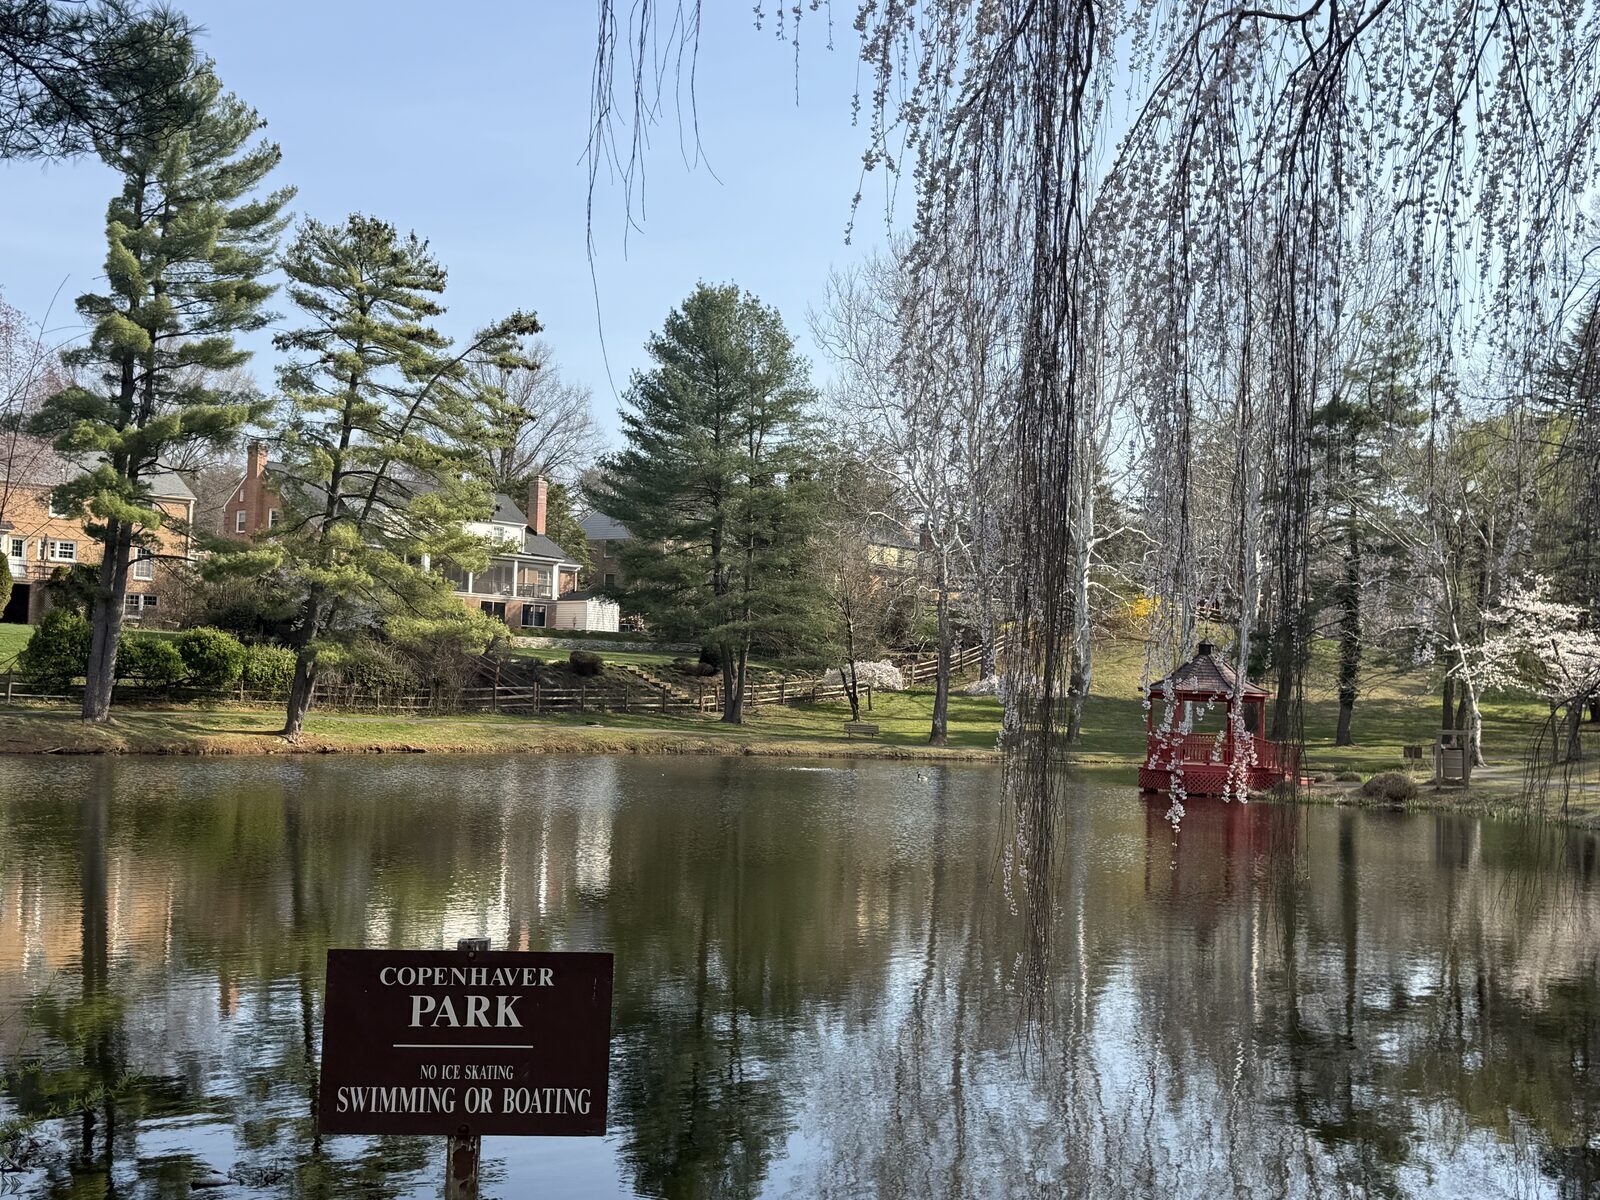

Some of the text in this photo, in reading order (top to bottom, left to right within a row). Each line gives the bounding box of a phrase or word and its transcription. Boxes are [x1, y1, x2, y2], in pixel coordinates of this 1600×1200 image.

[380, 967, 554, 986] COPENHAVER
[408, 996, 523, 1027] PARK
[421, 1065, 513, 1079] NO ICE SKATING
[337, 1087, 591, 1114] SWIMMING OR BOATING
